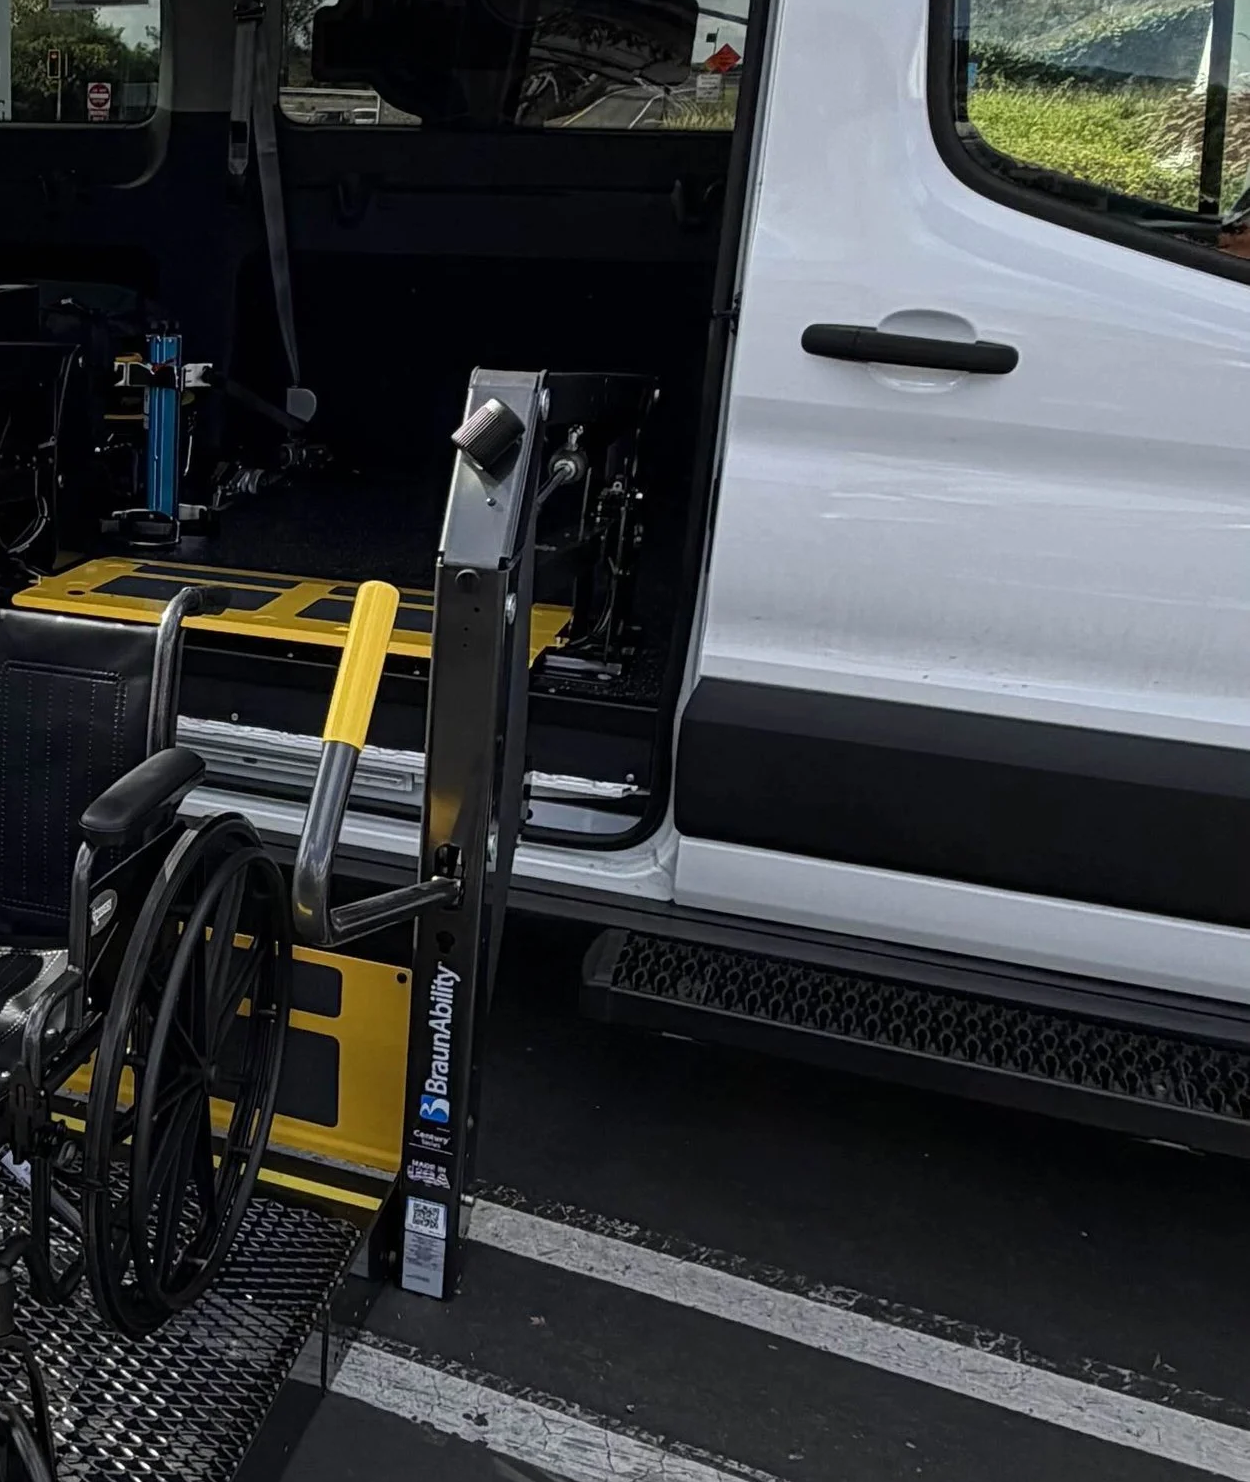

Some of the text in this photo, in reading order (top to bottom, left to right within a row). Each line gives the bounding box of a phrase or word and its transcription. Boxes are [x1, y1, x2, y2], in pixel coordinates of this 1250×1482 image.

[425, 964, 461, 1096] BraunAbility
[413, 1129, 449, 1146] Century
[412, 1159, 447, 1174] MADE IN
